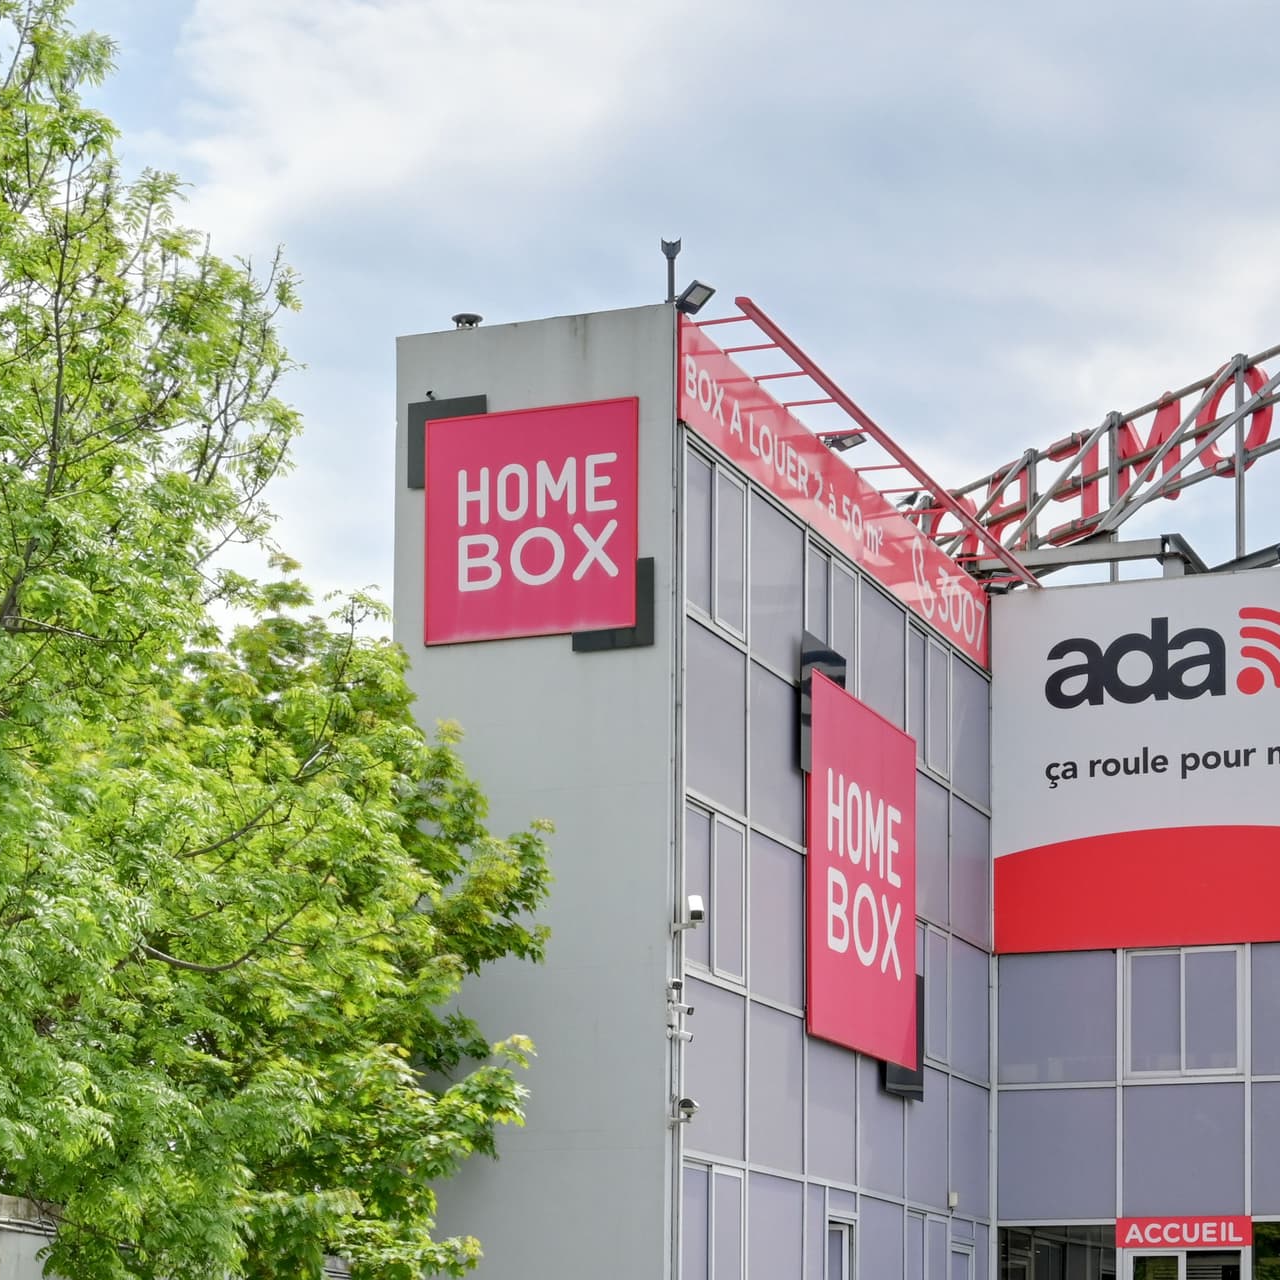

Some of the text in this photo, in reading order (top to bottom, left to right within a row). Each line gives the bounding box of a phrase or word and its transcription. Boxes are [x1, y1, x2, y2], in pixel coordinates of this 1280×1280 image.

[457, 451, 618, 527] HOME
[685, 353, 726, 428] BOX
[749, 412, 809, 498] LOUER
[814, 470, 826, 511] 2
[828, 483, 837, 522] à
[842, 495, 863, 540] 50
[937, 566, 986, 651] 3007
[458, 518, 619, 592] BOX
[1044, 616, 1227, 709] ada
[1044, 757, 1079, 789] ça
[1089, 745, 1169, 779] roule
[1180, 743, 1257, 780] pour
[827, 767, 902, 888] HOME
[827, 866, 902, 982] BOX
[1124, 1221, 1244, 1244] ACCUEIL
